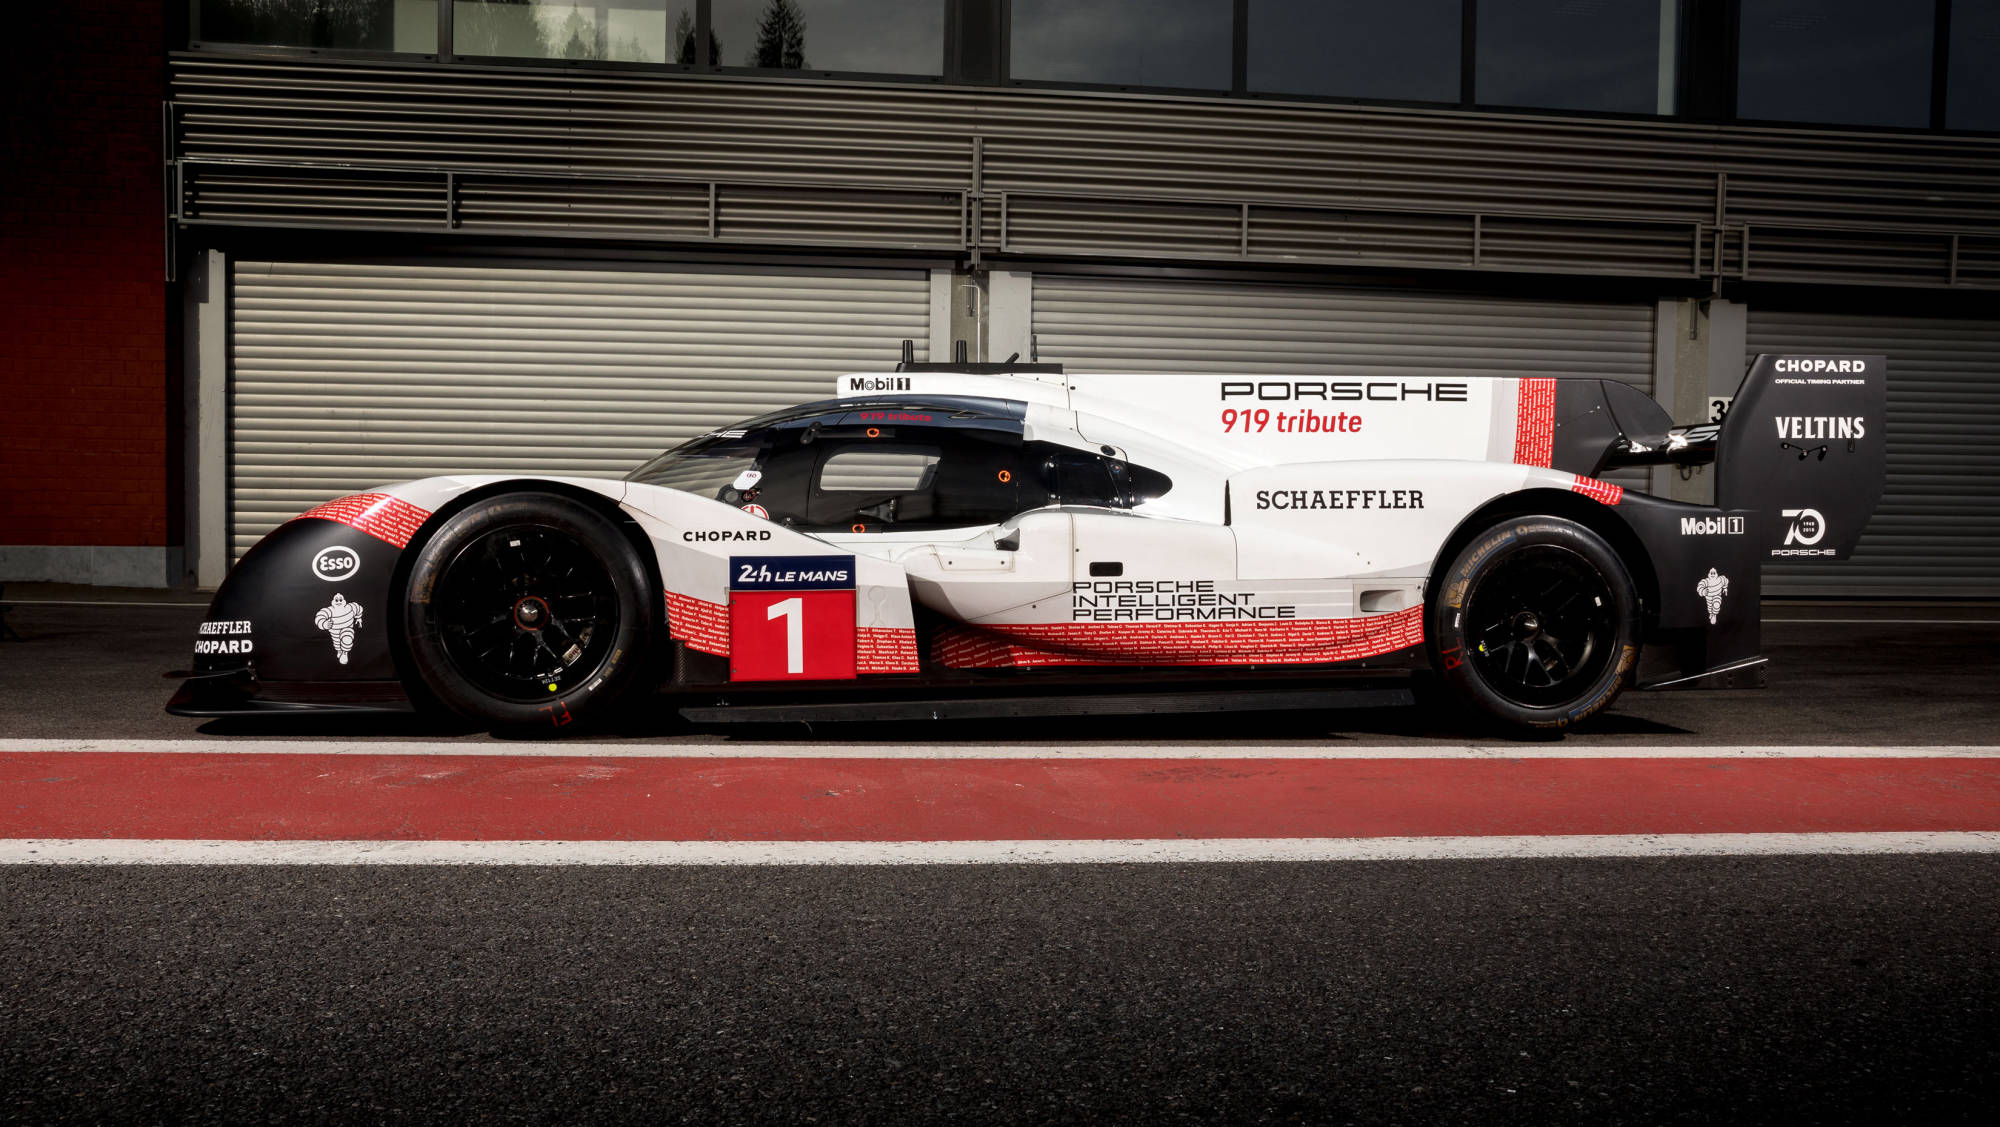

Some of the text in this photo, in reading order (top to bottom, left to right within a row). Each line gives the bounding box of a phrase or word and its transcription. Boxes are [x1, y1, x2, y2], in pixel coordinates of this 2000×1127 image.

[1775, 359, 1866, 373] CHOPARD
[850, 377, 911, 391] Mobil 1
[1221, 383, 1468, 402] PORSCHE
[860, 411, 932, 422] 919 tribute
[1221, 408, 1362, 433] 919 tribute
[1711, 400, 1733, 425] 3
[1775, 416, 1865, 439] VELTINS
[1256, 490, 1425, 510] SCHAEFFLER
[1680, 516, 1744, 536] Mobil 1
[1781, 508, 1826, 546] 70
[682, 530, 772, 542] CHOPARD
[319, 555, 353, 571] Esso
[737, 564, 848, 583] 24h LE MANS
[1073, 581, 1214, 593] PORSCHE
[1073, 594, 1255, 607] INTELLIGENT
[1073, 606, 1296, 621] PERFORMANCE
[767, 597, 804, 674] 1
